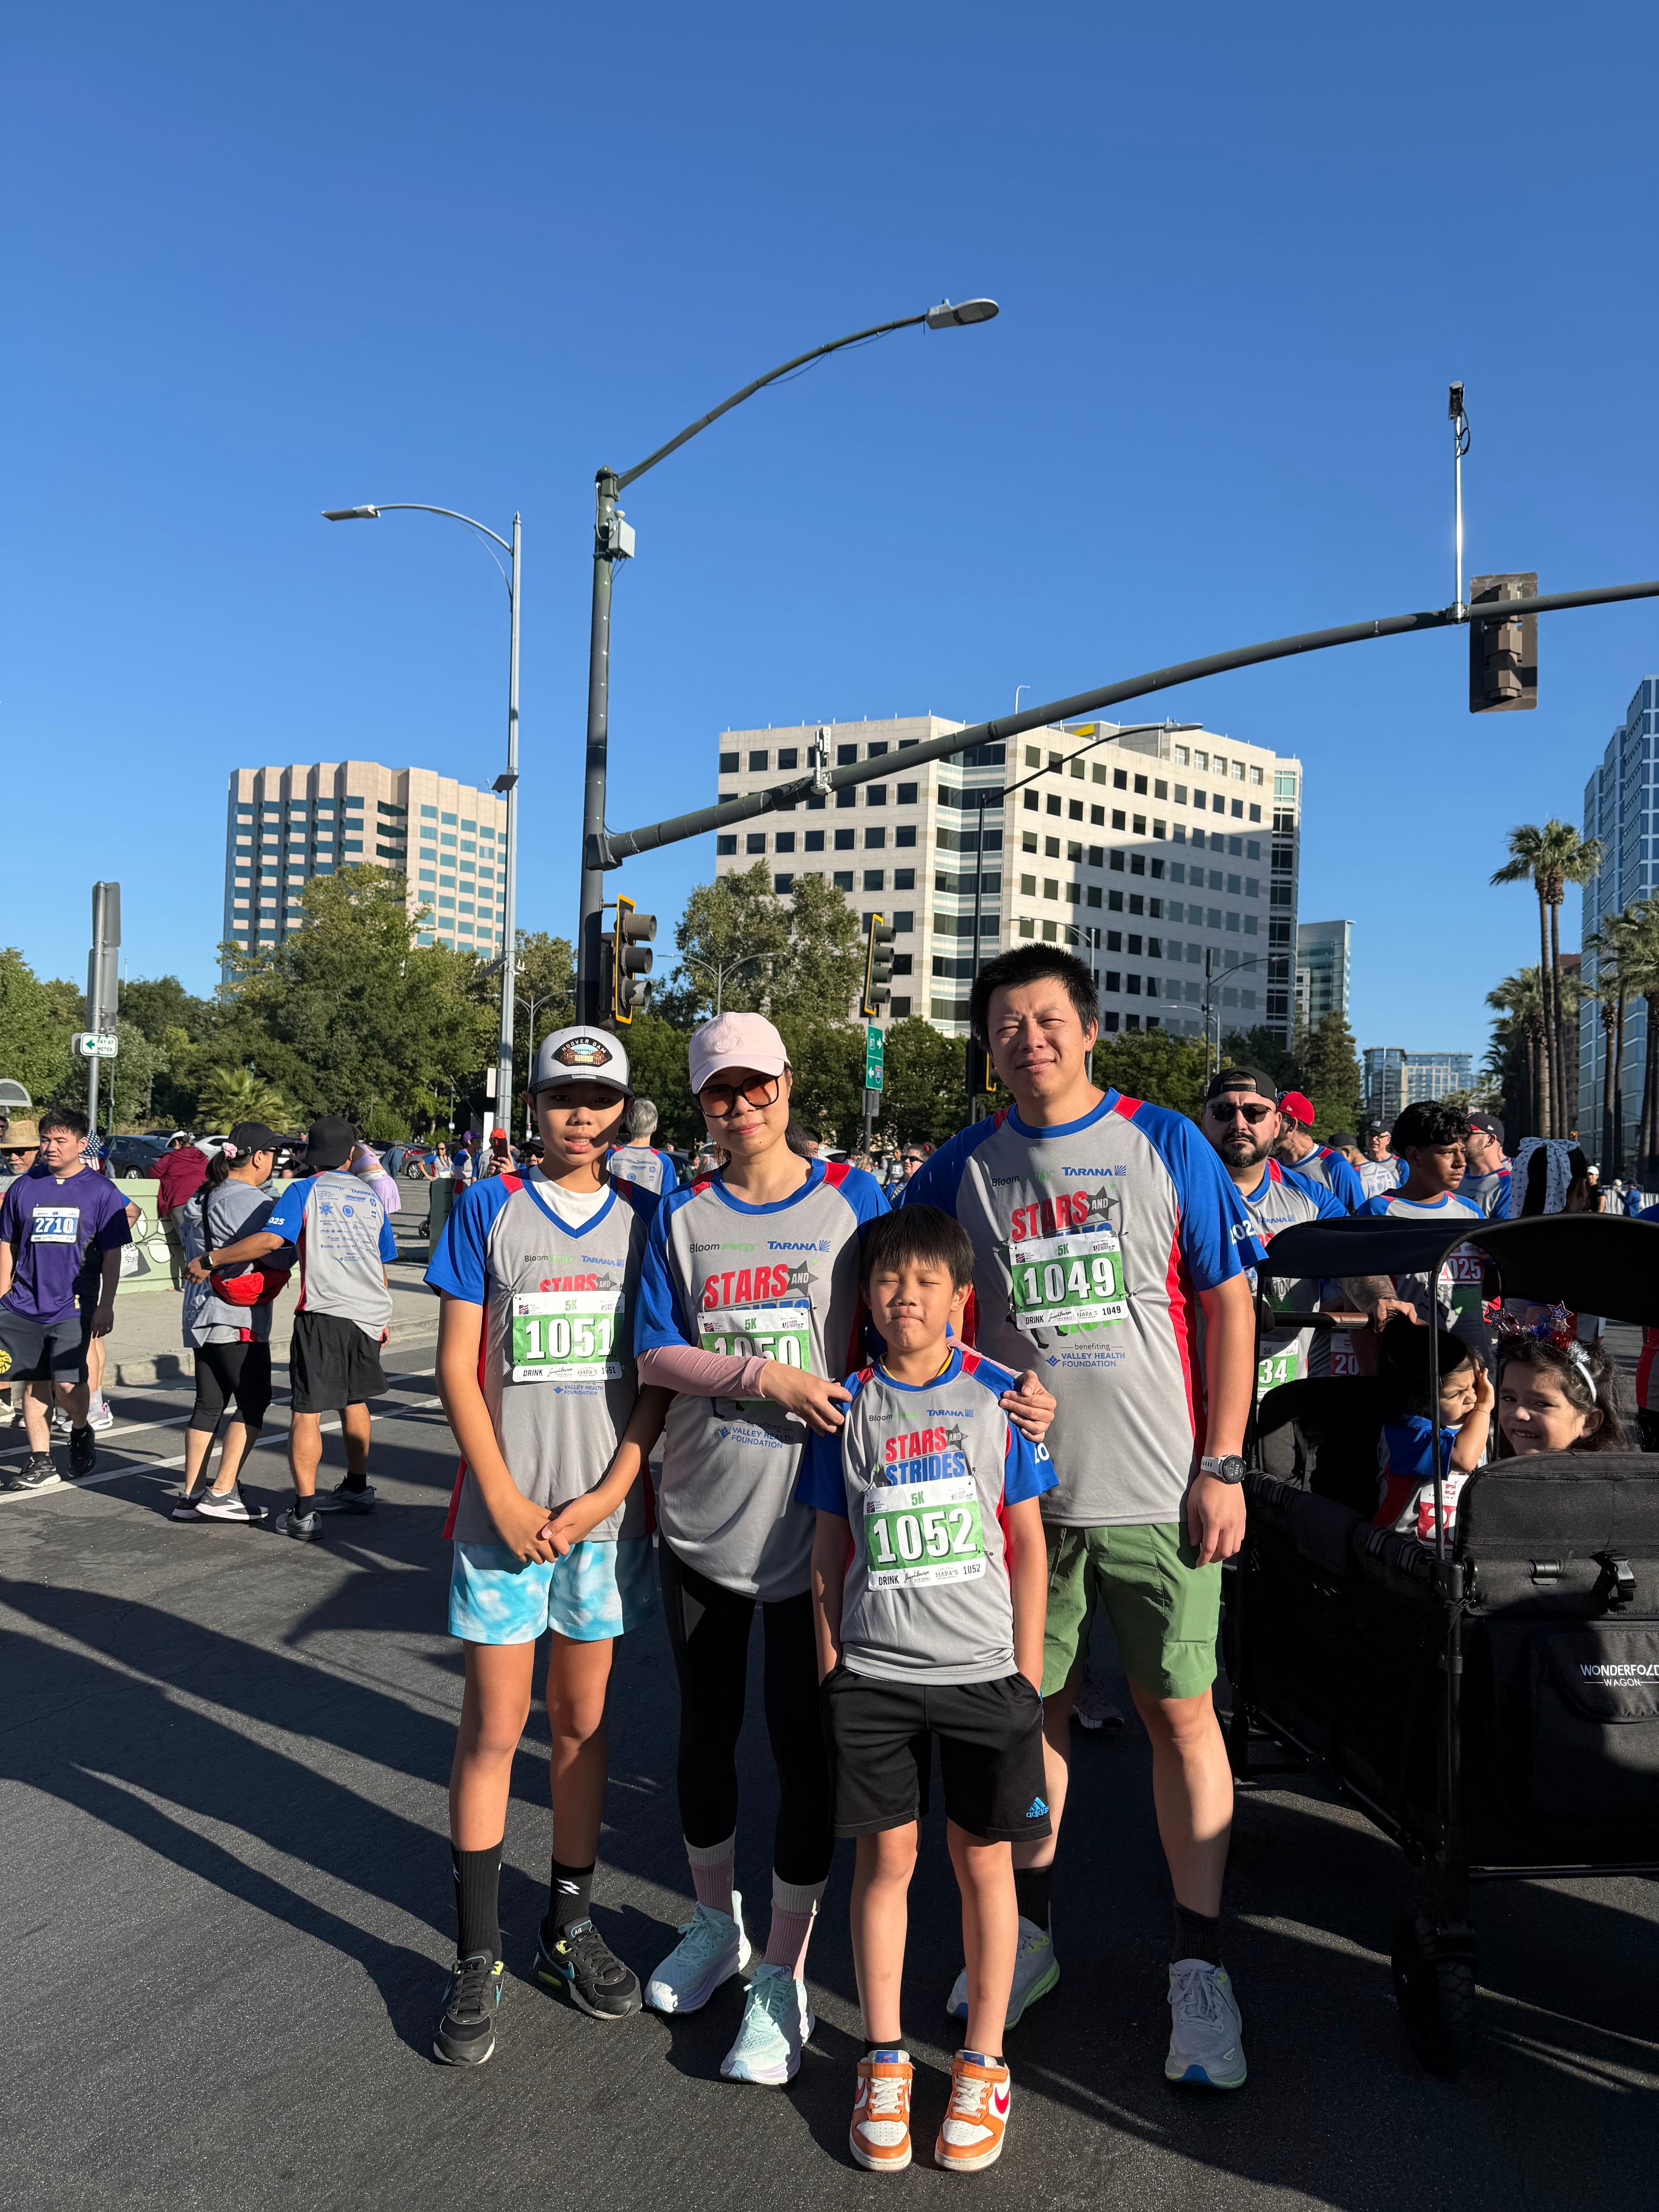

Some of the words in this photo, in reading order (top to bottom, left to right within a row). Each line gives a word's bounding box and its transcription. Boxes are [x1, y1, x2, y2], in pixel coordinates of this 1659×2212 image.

[562, 1039, 589, 1052] HOOVER
[592, 1042, 607, 1054] DAM
[1062, 1167, 1113, 1176] TARANA
[1011, 1191, 1088, 1242] STARS
[1092, 1198, 1108, 1210] AND
[35, 1217, 74, 1233] 2710
[767, 1241, 817, 1251] TARANA
[1058, 1243, 1069, 1256] 5K
[581, 1255, 616, 1266] TARANA
[599, 1280, 610, 1288] AND
[703, 1264, 788, 1308] STARS
[791, 1272, 809, 1284] AND
[1023, 1257, 1116, 1306] 1049
[565, 1300, 577, 1311] 5K
[1026, 1316, 1044, 1325] DRINK
[1103, 1306, 1121, 1316] 1049
[745, 1318, 756, 1331] 5K
[525, 1318, 612, 1360] 1051
[601, 1366, 616, 1374] 1051
[747, 1420, 781, 1432] benefiting
[733, 1427, 762, 1437] VALLEY
[764, 1433, 794, 1442] HEALTH
[731, 1435, 782, 1449] FOUNDATION
[885, 1427, 947, 1462] STARS
[949, 1433, 961, 1442] AND
[886, 1452, 964, 1486] STRIDES
[911, 1491, 925, 1506] 5K
[873, 1508, 978, 1564] 1052
[879, 1575, 899, 1586] DRINK
[963, 1564, 980, 1575] 1052
[1580, 1664, 1659, 1676] WONDERFOLD
[1604, 1678, 1642, 1687] WAGON
[1026, 1806, 1049, 1818] adidas
